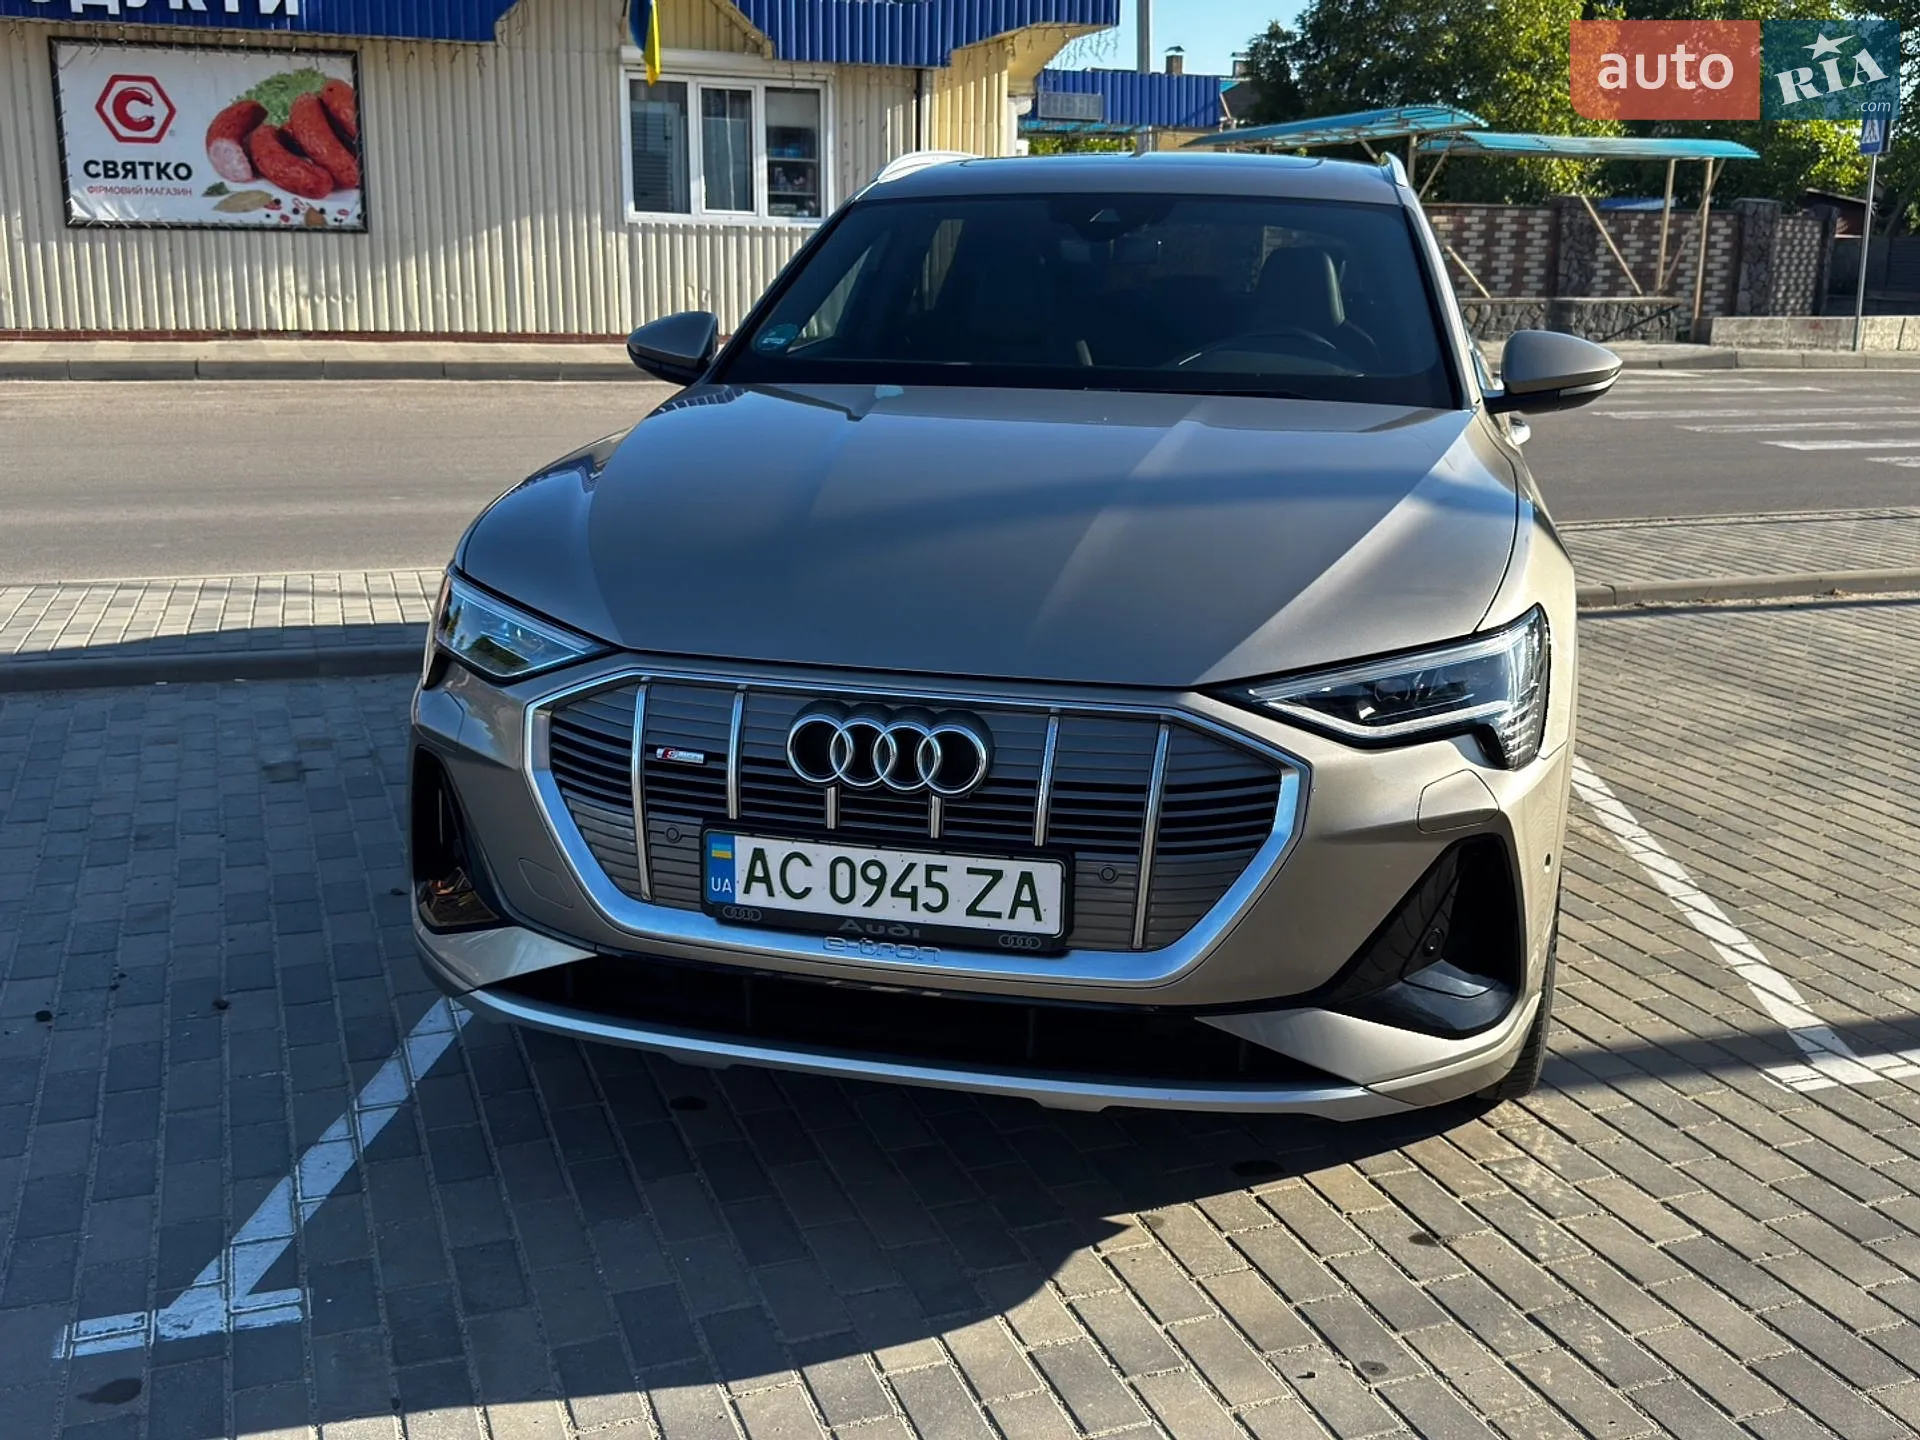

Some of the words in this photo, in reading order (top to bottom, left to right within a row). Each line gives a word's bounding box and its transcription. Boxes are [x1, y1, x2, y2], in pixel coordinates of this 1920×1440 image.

[83, 159, 193, 181] СВЯТКО
[87, 185, 142, 195] ФІРМОВИЙ
[145, 187, 193, 197] МАГАЗИН
[711, 876, 733, 893] UA
[743, 847, 813, 900] AC
[829, 856, 949, 914] 0945
[965, 867, 1043, 922] ZA
[838, 920, 921, 939] Audi
